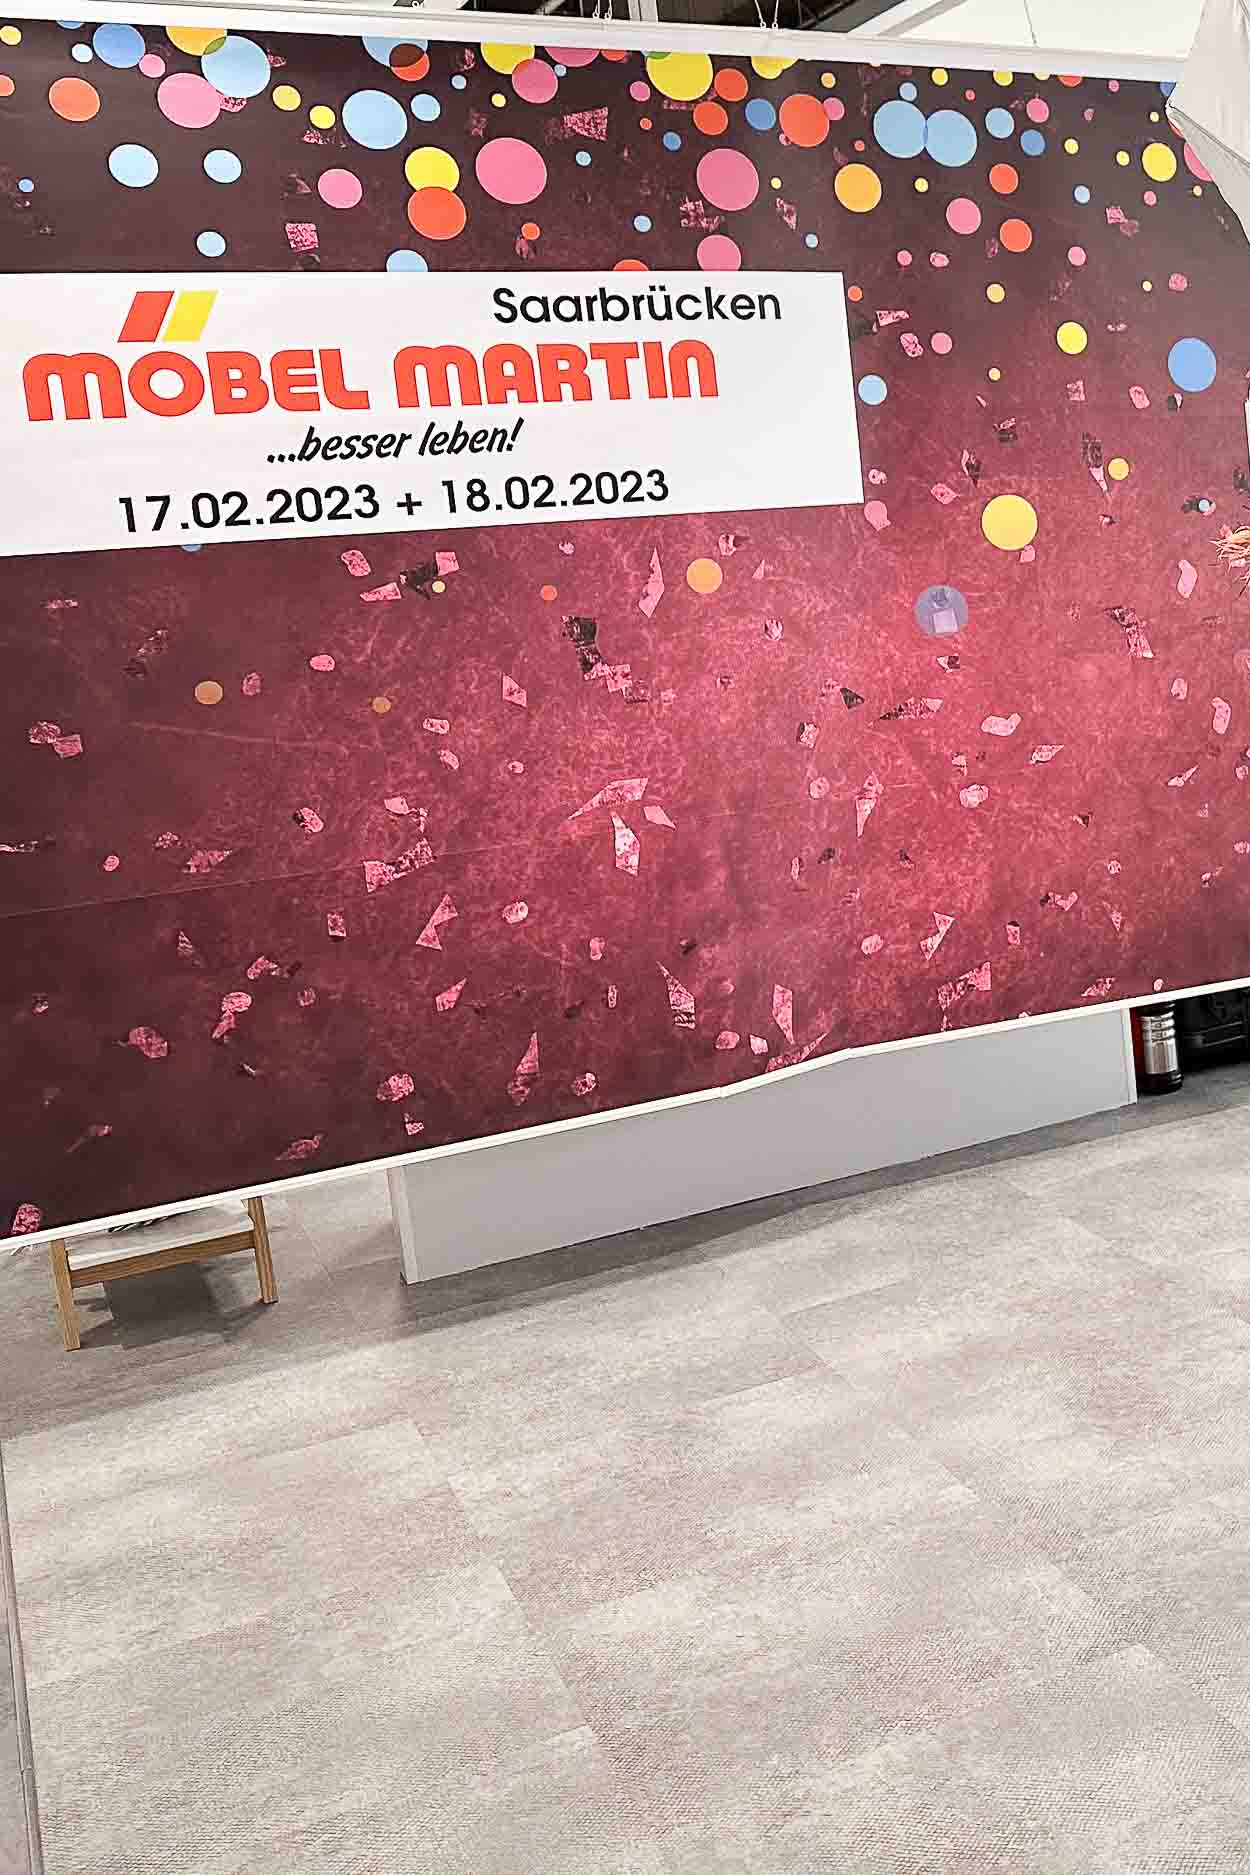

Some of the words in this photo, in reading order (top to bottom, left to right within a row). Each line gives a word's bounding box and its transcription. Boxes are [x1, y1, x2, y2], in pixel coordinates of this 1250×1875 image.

[492, 285, 782, 324] Saarbrücken
[22, 290, 370, 422] MÖBEL
[392, 339, 719, 409] MARTIN
[265, 425, 413, 465] ...besser
[418, 416, 525, 457] leben!
[118, 484, 380, 533] 17.02.2023
[396, 492, 423, 516] +
[441, 468, 669, 514] 18.02.2023
